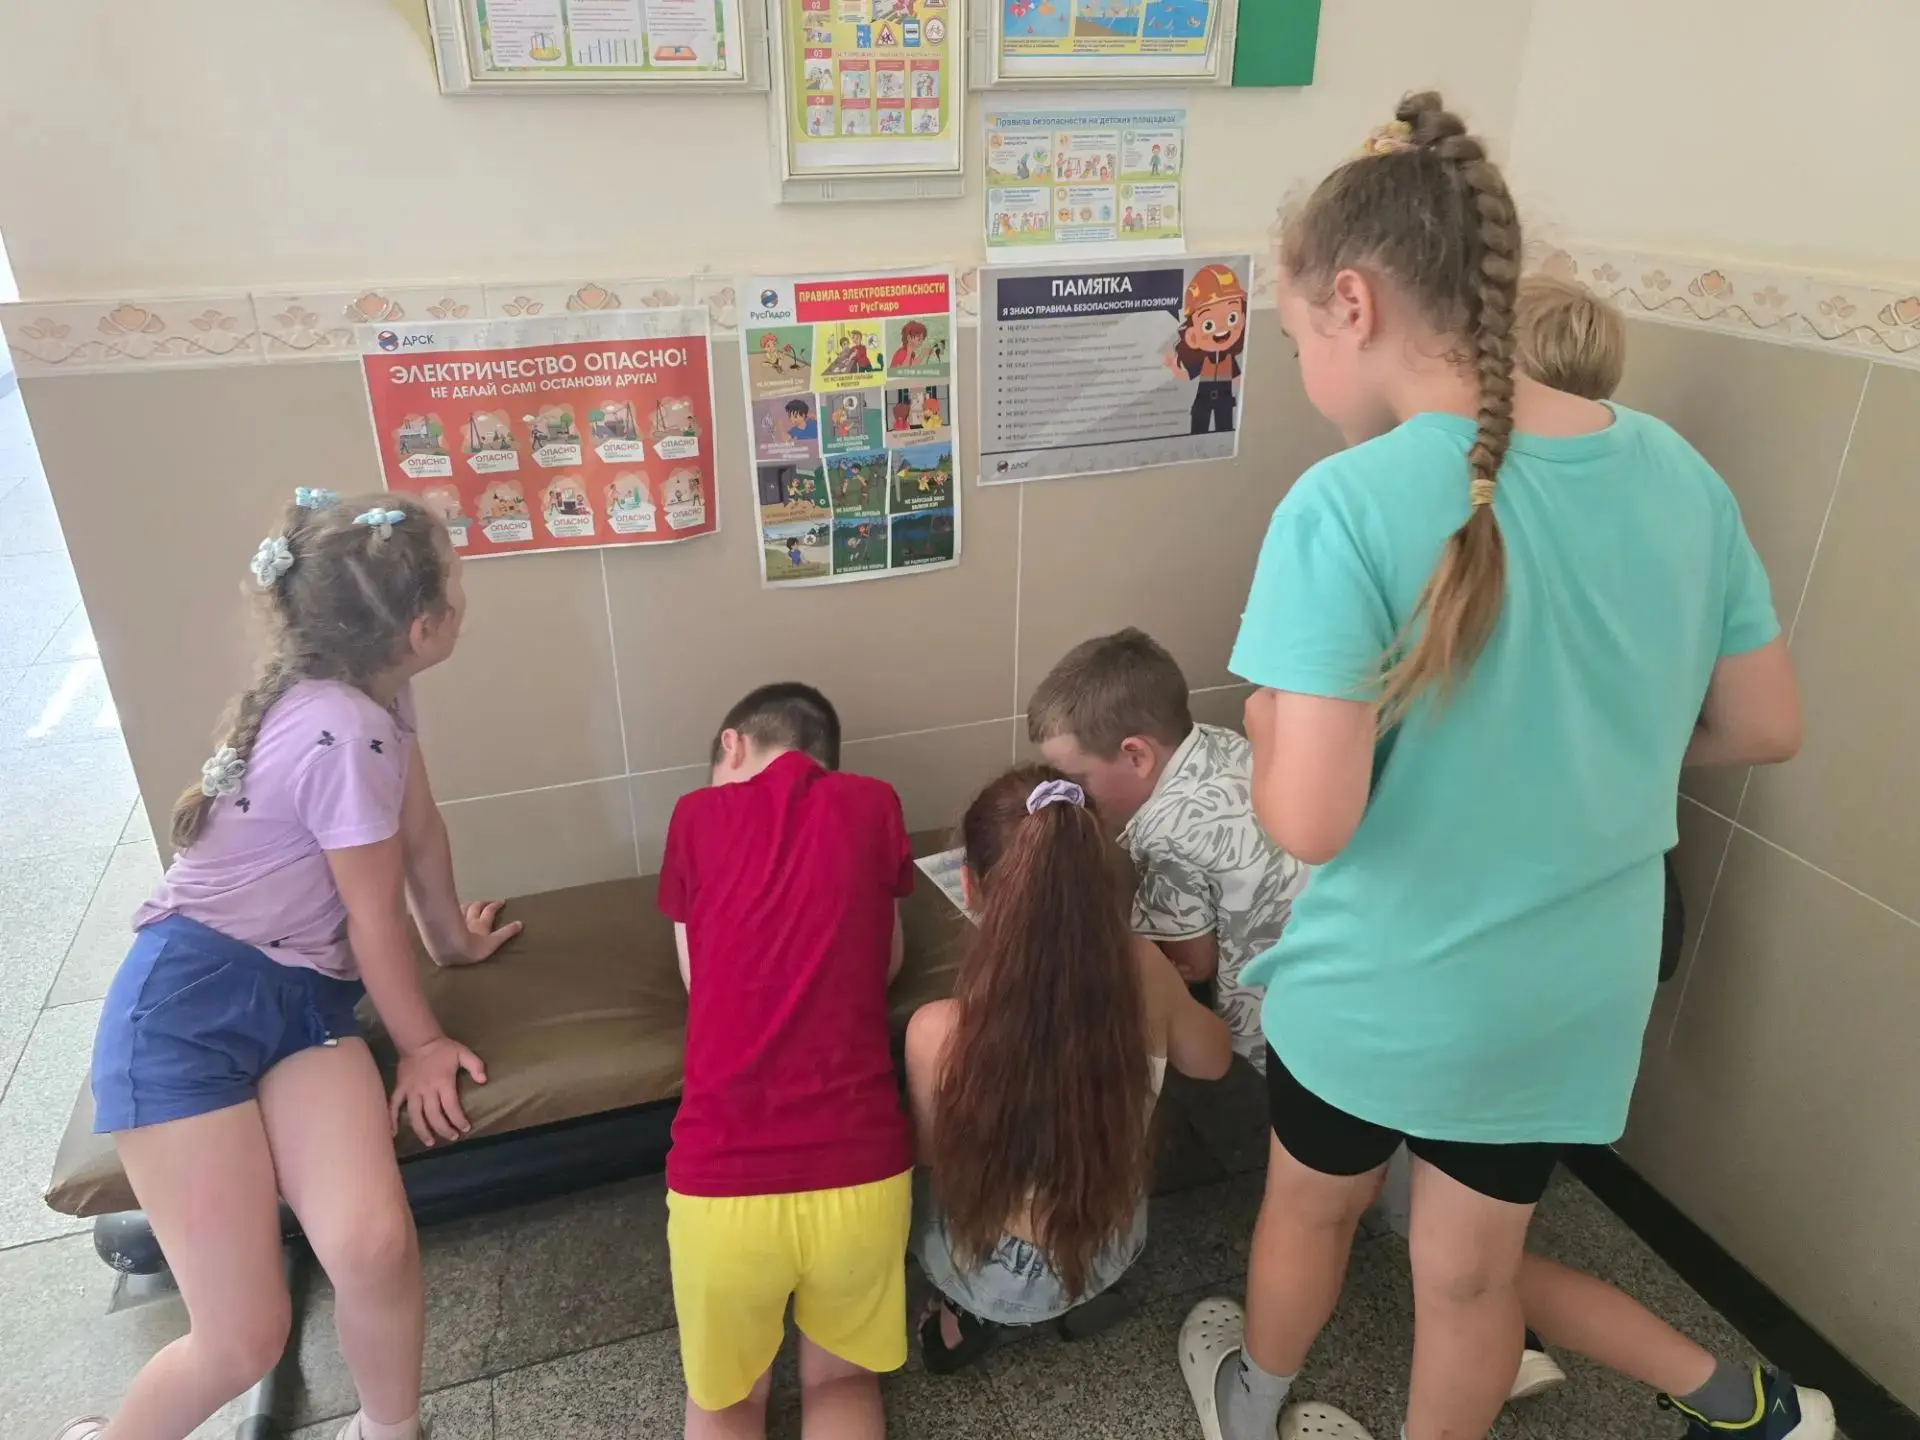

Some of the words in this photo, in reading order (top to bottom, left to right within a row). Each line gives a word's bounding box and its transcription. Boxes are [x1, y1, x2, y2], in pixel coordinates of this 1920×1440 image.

[995, 117, 1031, 128] Правила
[1032, 116, 1087, 126] безопасности
[1051, 276, 1133, 297] ПАМЯТКА
[799, 290, 841, 303] ПРАВИЛА
[842, 282, 946, 300] ЭЛЕКТРОБЕЗОПАСНОСТИ
[849, 303, 858, 313] от
[860, 301, 900, 314] РусГидро
[1002, 308, 1008, 316] Я
[1009, 306, 1035, 316] ЗНАЮ
[1035, 304, 1073, 315] ПРАВИЛА
[1073, 299, 1134, 312] БЕЗОПАСНОСТИ
[1134, 299, 1141, 308] И
[1141, 297, 1179, 308] ПОЭТОМУ
[750, 310, 791, 320] РусГидро
[402, 334, 435, 347] ДРСК
[389, 354, 577, 384] ЭЛЕКТРИЧЕСТВО
[584, 347, 688, 371] ОПАСНО!
[430, 386, 449, 399] НЕ
[452, 381, 498, 400] ДЕЛАЙ
[500, 381, 537, 395] САМ!
[540, 374, 613, 391] ОСТАНОВИ
[615, 372, 658, 388] ДРУГА!
[603, 443, 640, 451] ОПАСНО
[660, 439, 695, 448] ОПАСНО
[540, 446, 577, 457] ОПАСНО
[407, 457, 447, 466] ОПАСНО
[475, 452, 515, 463] ОПАСНО
[615, 513, 652, 521] ОПАСНО
[672, 507, 703, 518] ОПАСНО
[490, 521, 528, 531] ОПАСНО
[553, 517, 590, 526] ОПАСНО
